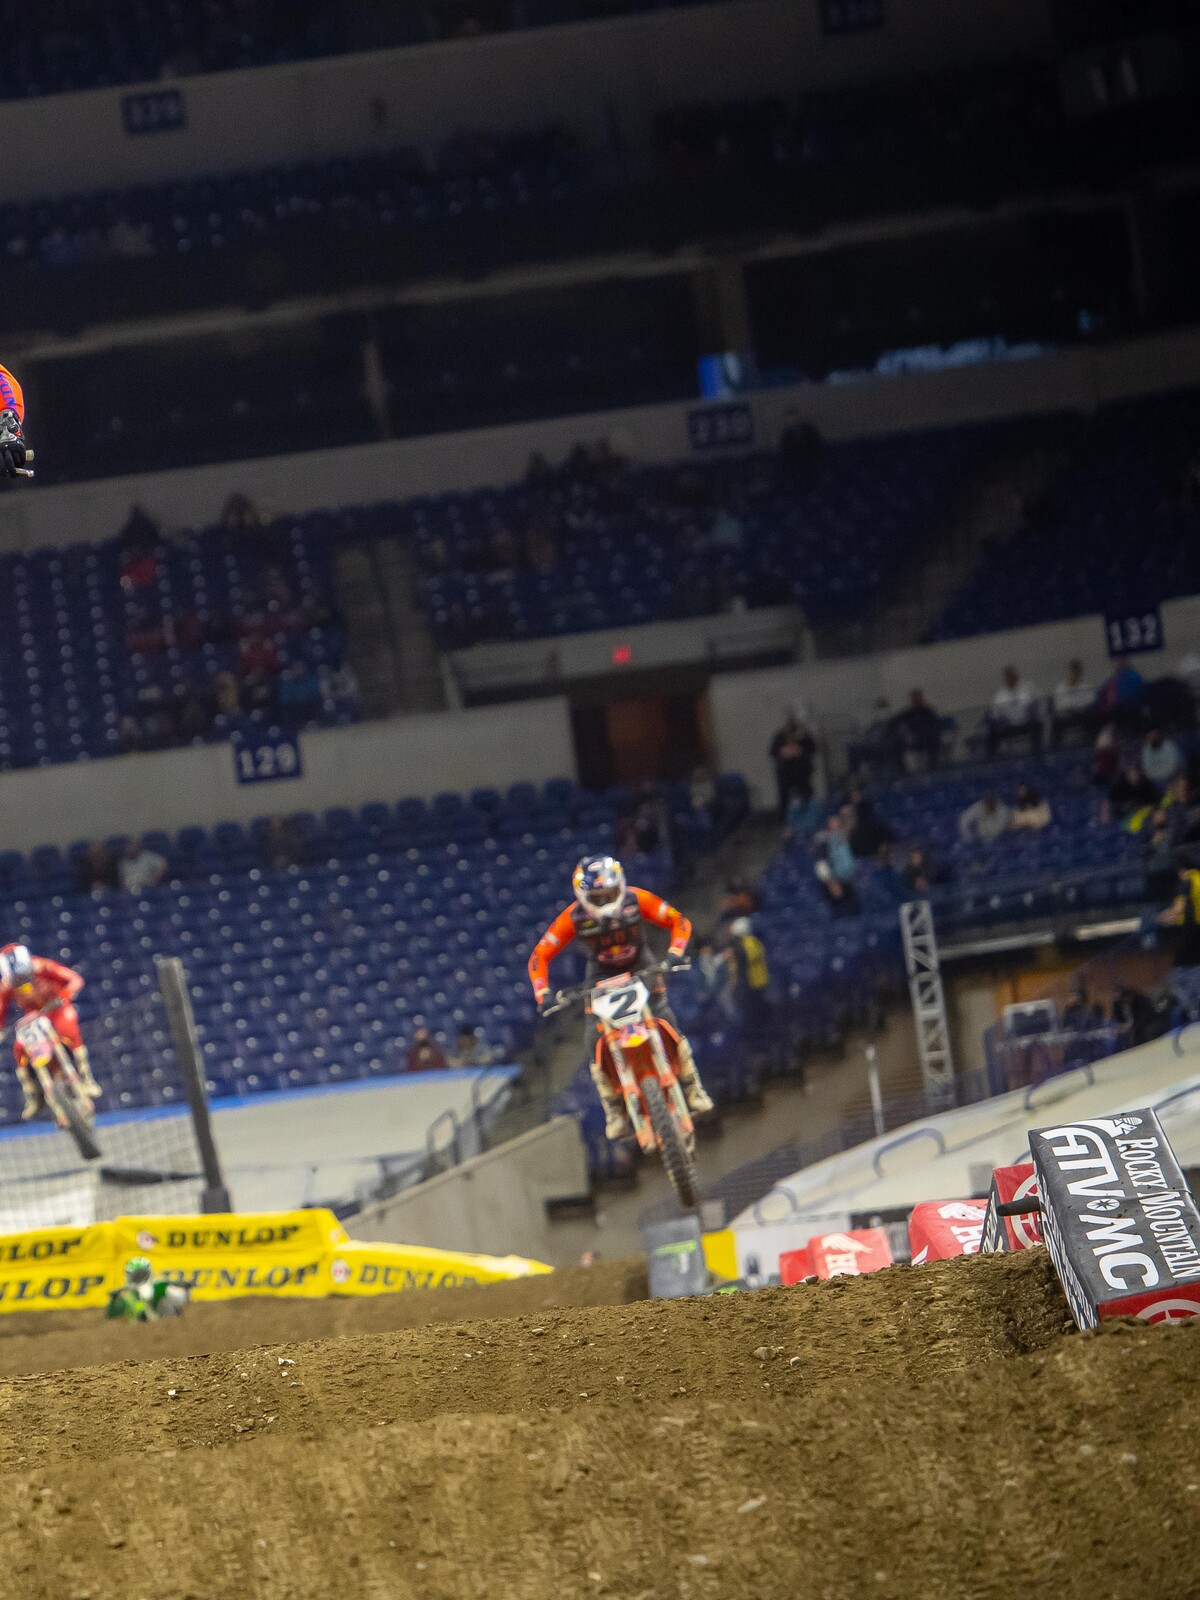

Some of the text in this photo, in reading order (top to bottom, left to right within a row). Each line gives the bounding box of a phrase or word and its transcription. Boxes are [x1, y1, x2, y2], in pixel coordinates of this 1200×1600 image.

[609, 990, 638, 1021] 2
[1115, 1137, 1200, 1279] ROCKY MOUNTAIN
[167, 1225, 299, 1248] DUNLOP
